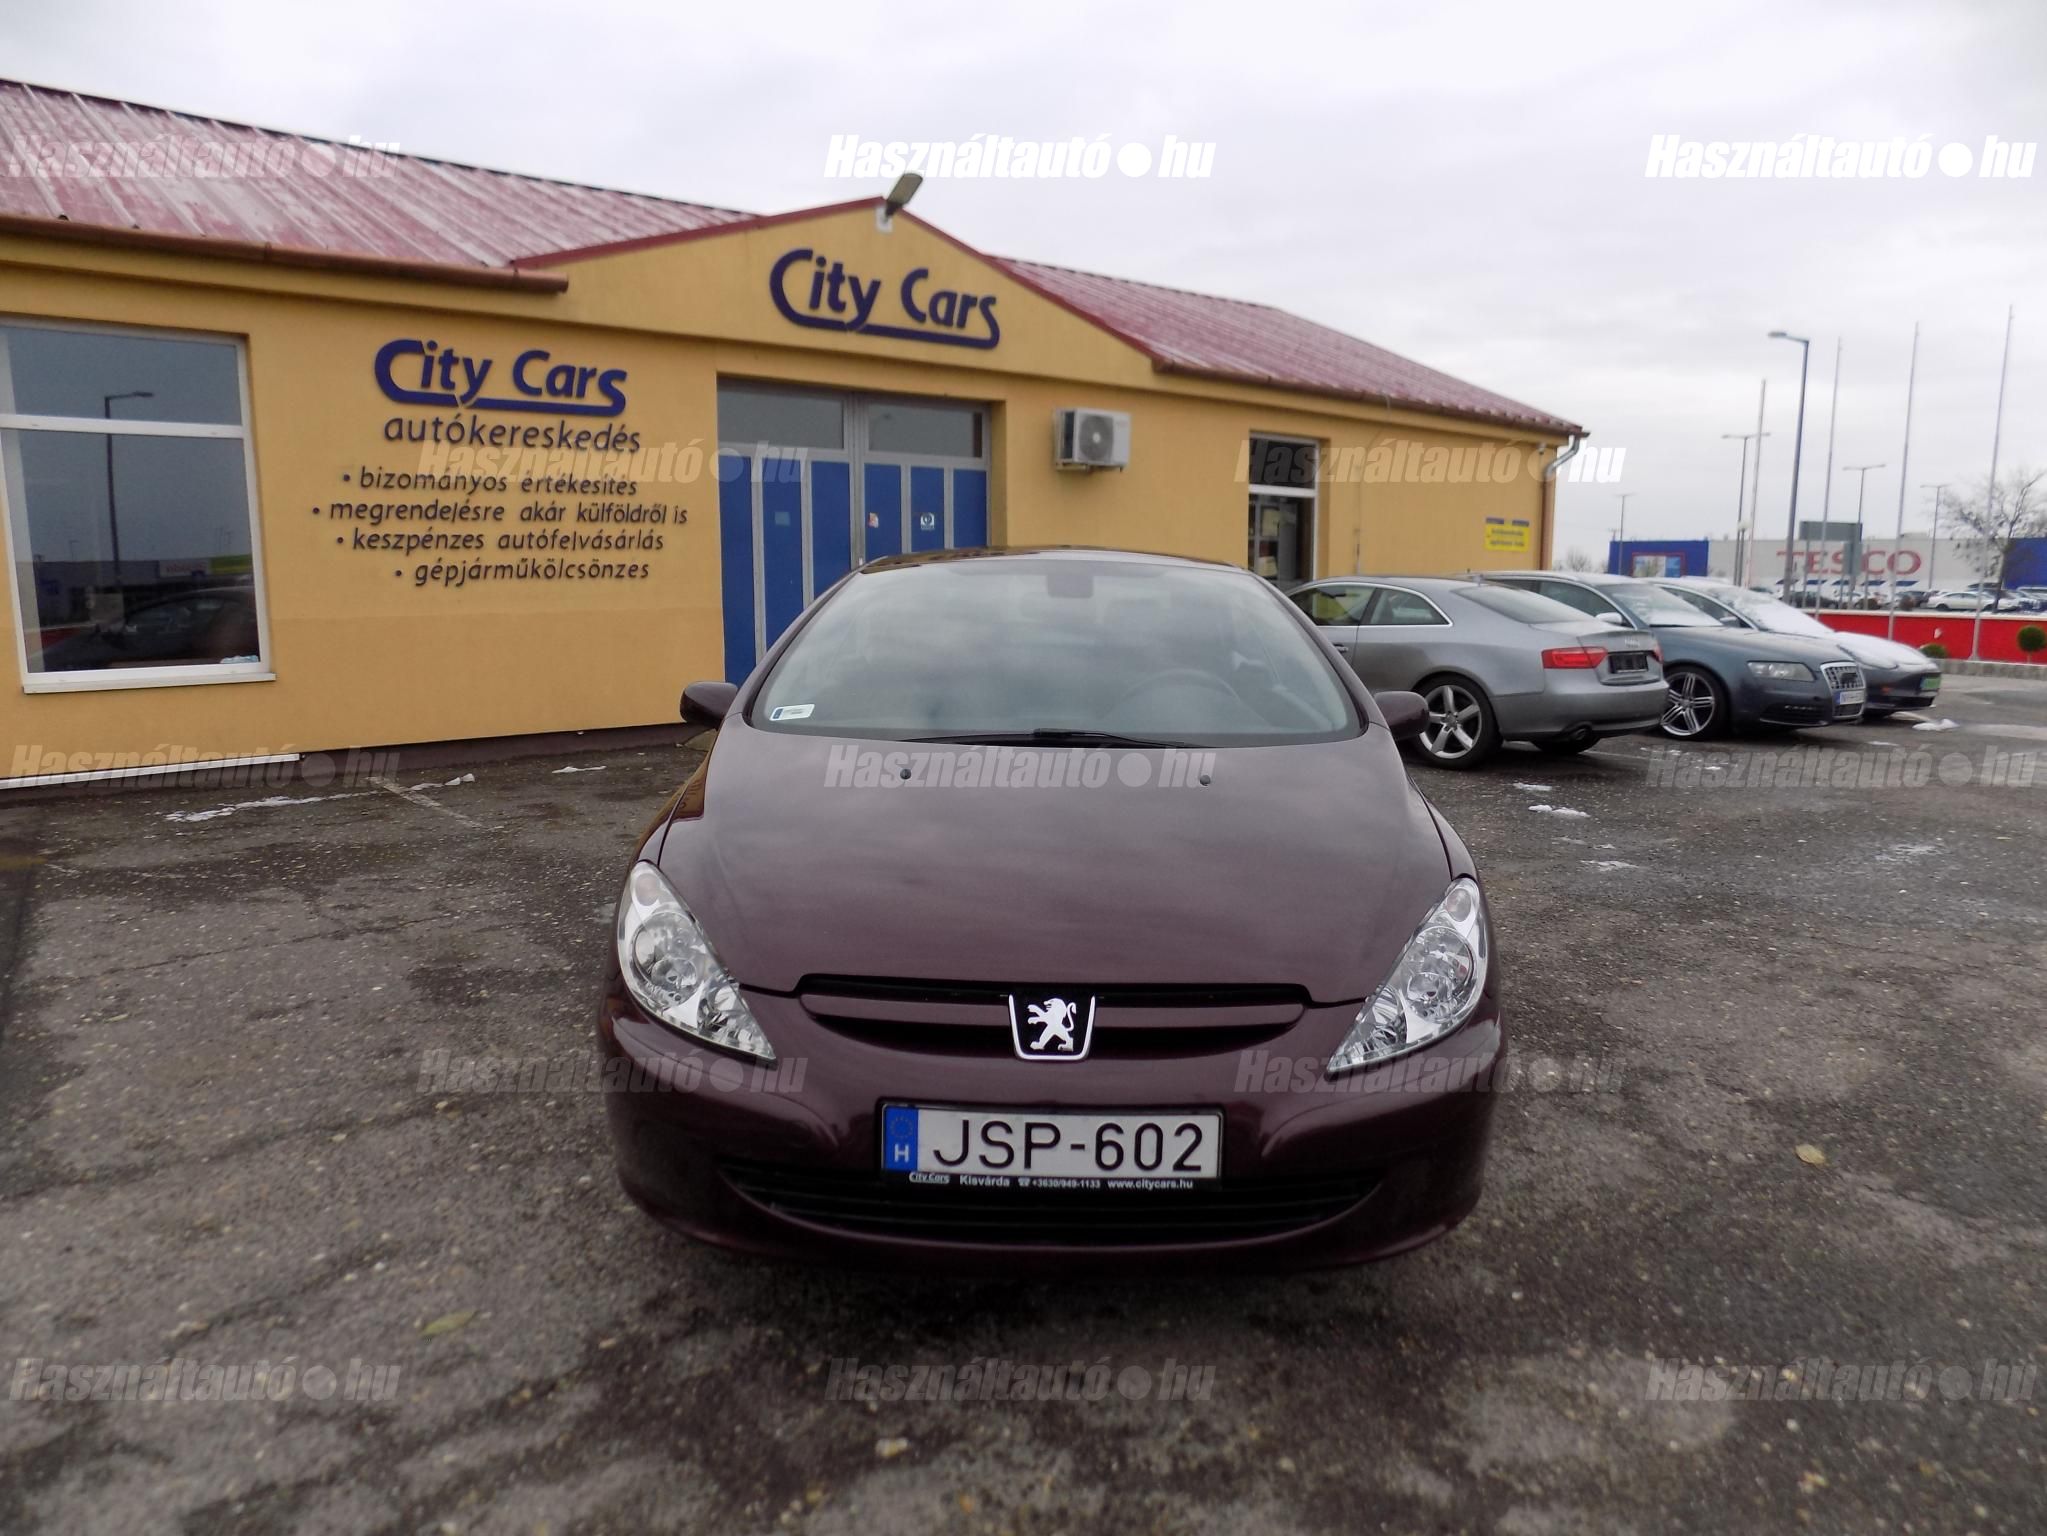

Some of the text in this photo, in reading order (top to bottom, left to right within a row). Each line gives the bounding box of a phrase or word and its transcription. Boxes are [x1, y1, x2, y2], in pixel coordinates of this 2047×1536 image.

[770, 249, 1000, 350] City Cars
[375, 339, 627, 418] City Cars
[384, 413, 641, 453] autókereskedés
[359, 466, 508, 495] bizományos
[329, 499, 689, 526] megrendelésre akár külföldről is
[497, 530, 665, 552] autófelvásárlás
[1776, 549, 1922, 576] TESCO
[894, 1143, 910, 1163] H
[933, 1119, 1203, 1172] JSP-602
[959, 1175, 1011, 1187] Kisvárda
[1107, 1179, 1194, 1191] www.citycars.hu
